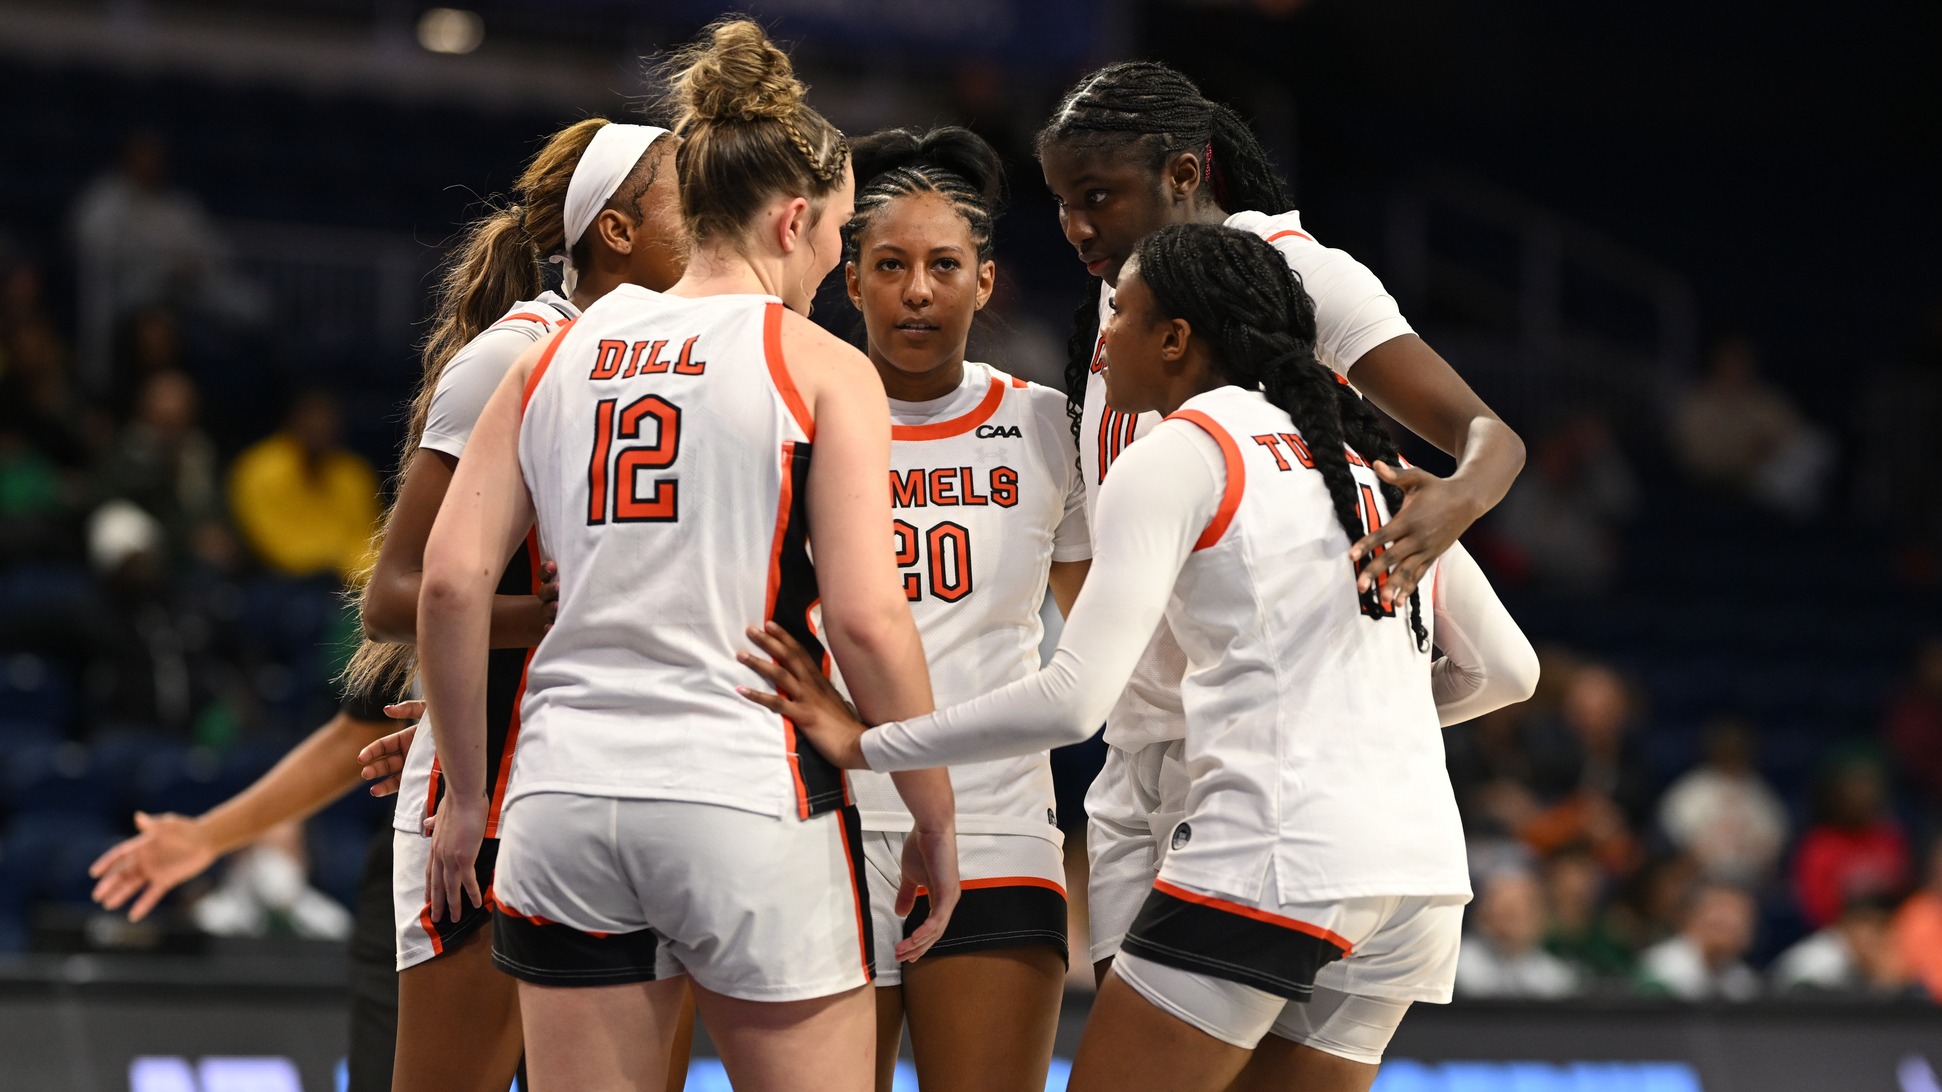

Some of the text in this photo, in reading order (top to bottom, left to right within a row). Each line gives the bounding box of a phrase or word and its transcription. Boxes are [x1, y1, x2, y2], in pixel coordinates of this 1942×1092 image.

[589, 334, 706, 380] DILL
[975, 425, 1022, 439] CAA
[587, 394, 682, 526] 12
[889, 465, 1019, 509] MELS
[893, 518, 973, 603] 20
